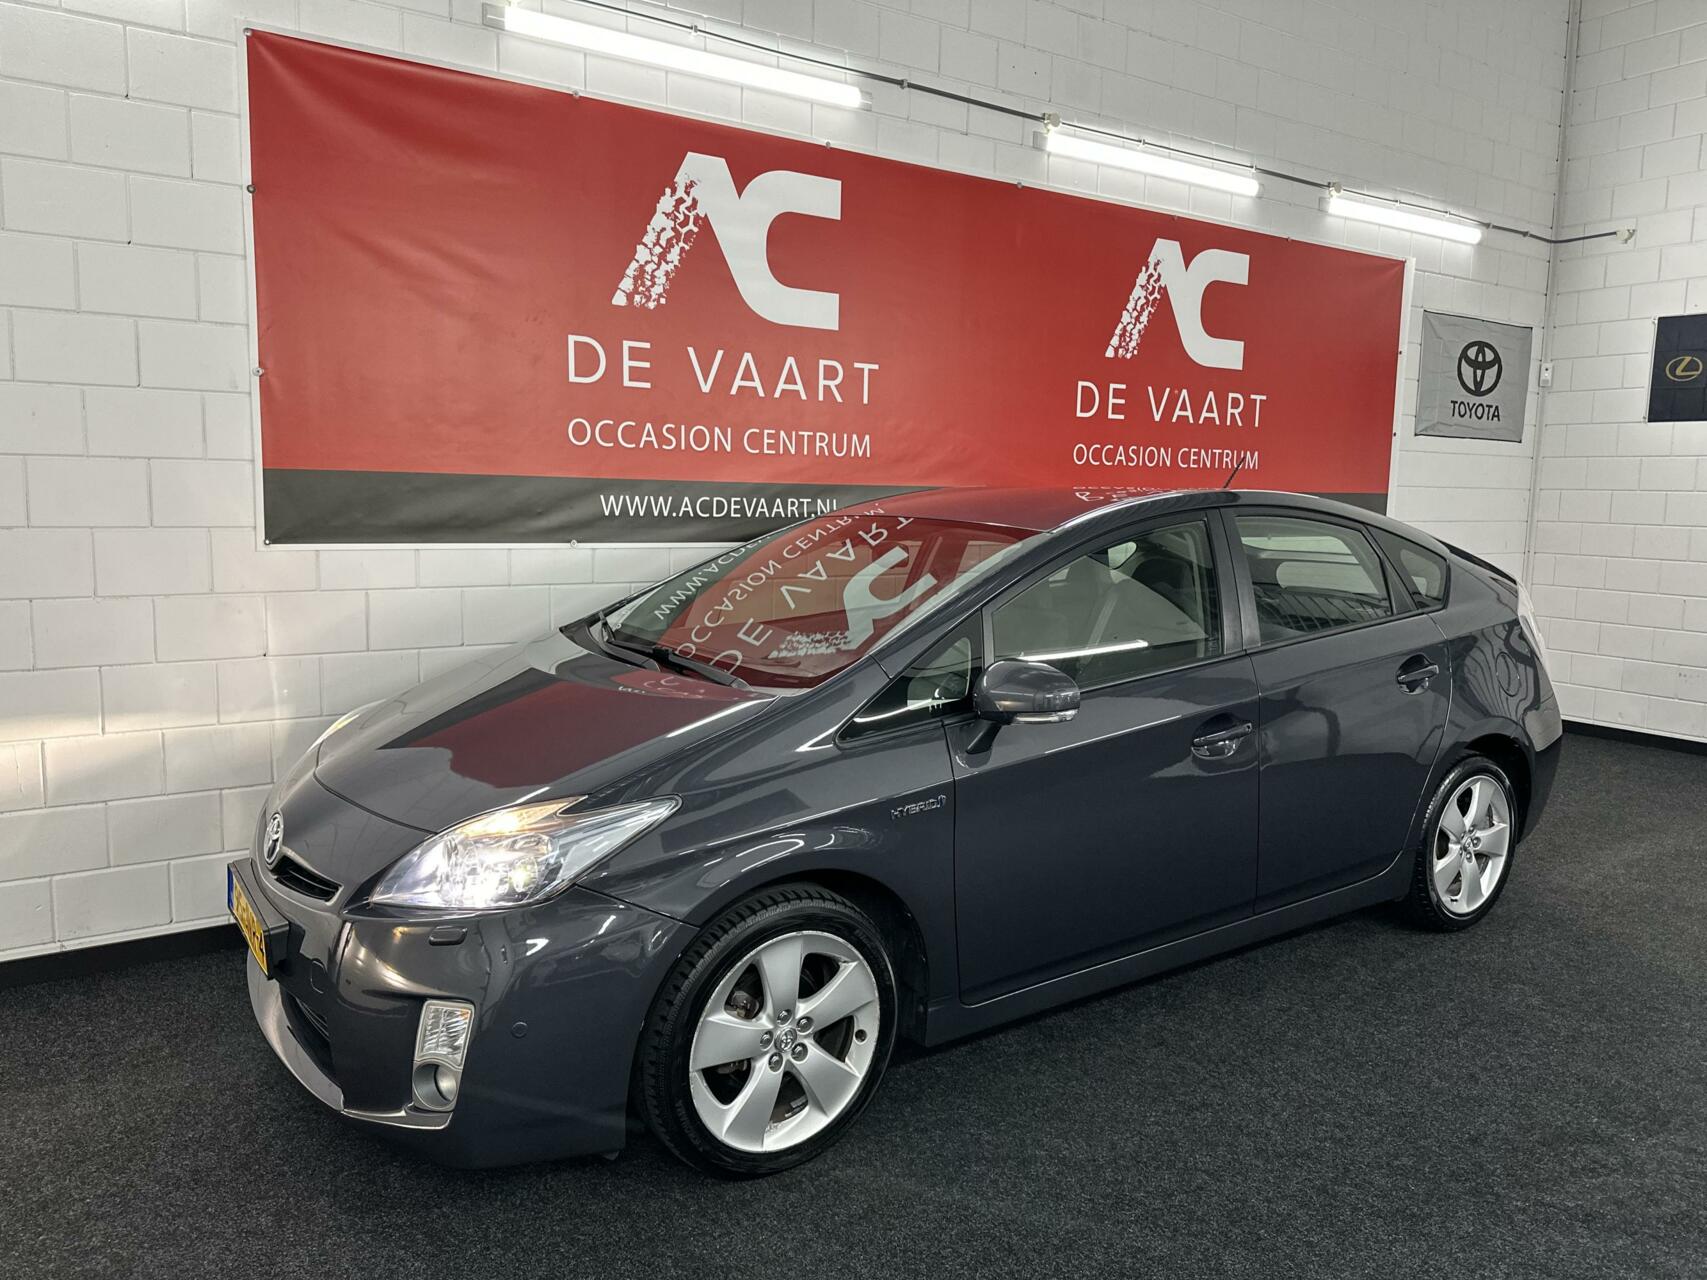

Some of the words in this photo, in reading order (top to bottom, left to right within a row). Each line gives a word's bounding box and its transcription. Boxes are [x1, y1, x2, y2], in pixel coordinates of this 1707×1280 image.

[567, 334, 652, 389] DE
[687, 346, 880, 405] VAART
[1076, 380, 1127, 420] DE
[1148, 386, 1267, 428] VAART
[1450, 399, 1501, 422] TOYOTA
[567, 417, 732, 453] OCCASION
[743, 428, 871, 458] CENTRUM
[1073, 443, 1171, 467] OCCASION
[1177, 447, 1259, 470] CENTRUM
